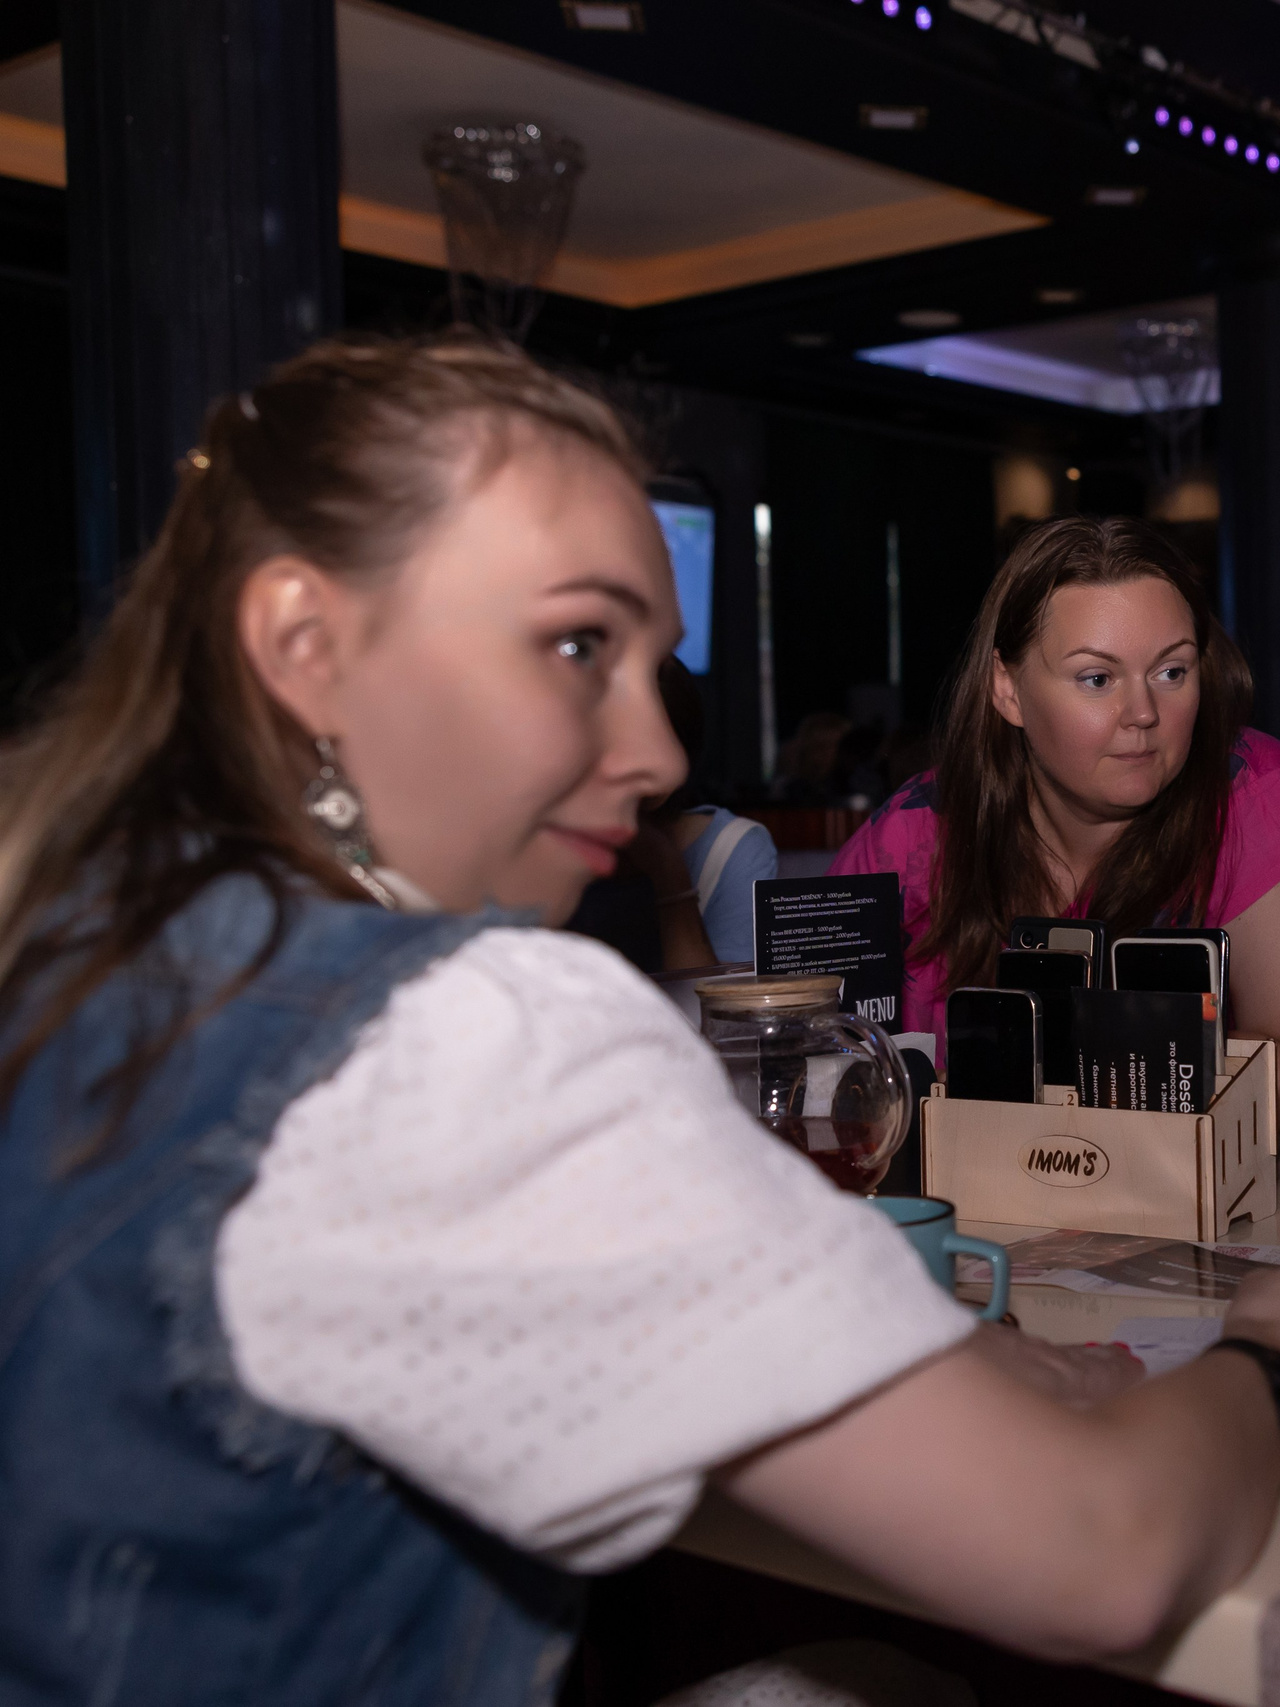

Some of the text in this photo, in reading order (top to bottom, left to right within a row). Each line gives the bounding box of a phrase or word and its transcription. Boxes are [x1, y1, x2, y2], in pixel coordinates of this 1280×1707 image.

[856, 996, 896, 1022] MENU
[1138, 1061, 1146, 1100] вкусная
[934, 1086, 942, 1098] 1
[1067, 1094, 1074, 1106] 2
